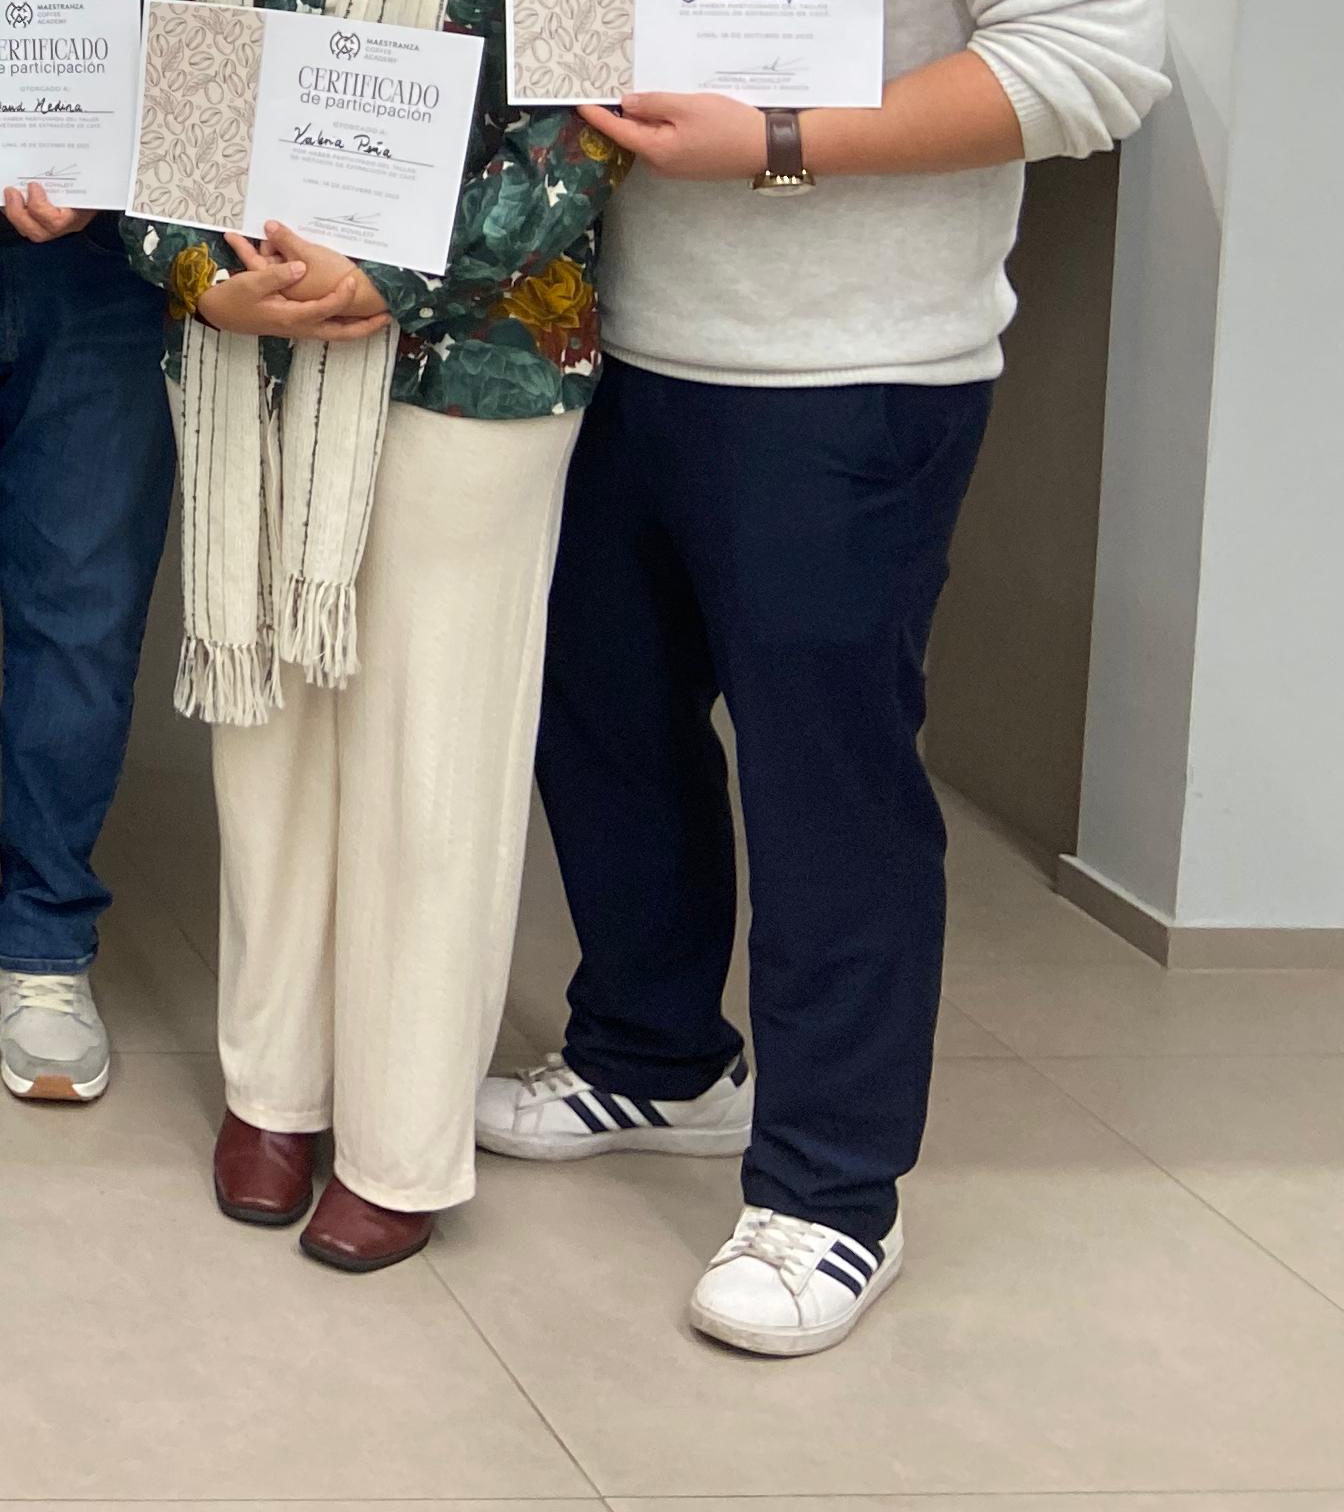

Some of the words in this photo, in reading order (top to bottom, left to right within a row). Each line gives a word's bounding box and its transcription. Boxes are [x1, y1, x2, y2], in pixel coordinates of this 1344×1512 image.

[367, 38, 420, 51] MAESTRANZA
[10, 61, 105, 76] participación
[298, 65, 439, 109] CERTIFICADO
[300, 90, 321, 105] de
[325, 95, 432, 123] participación
[353, 134, 392, 159] Peña
